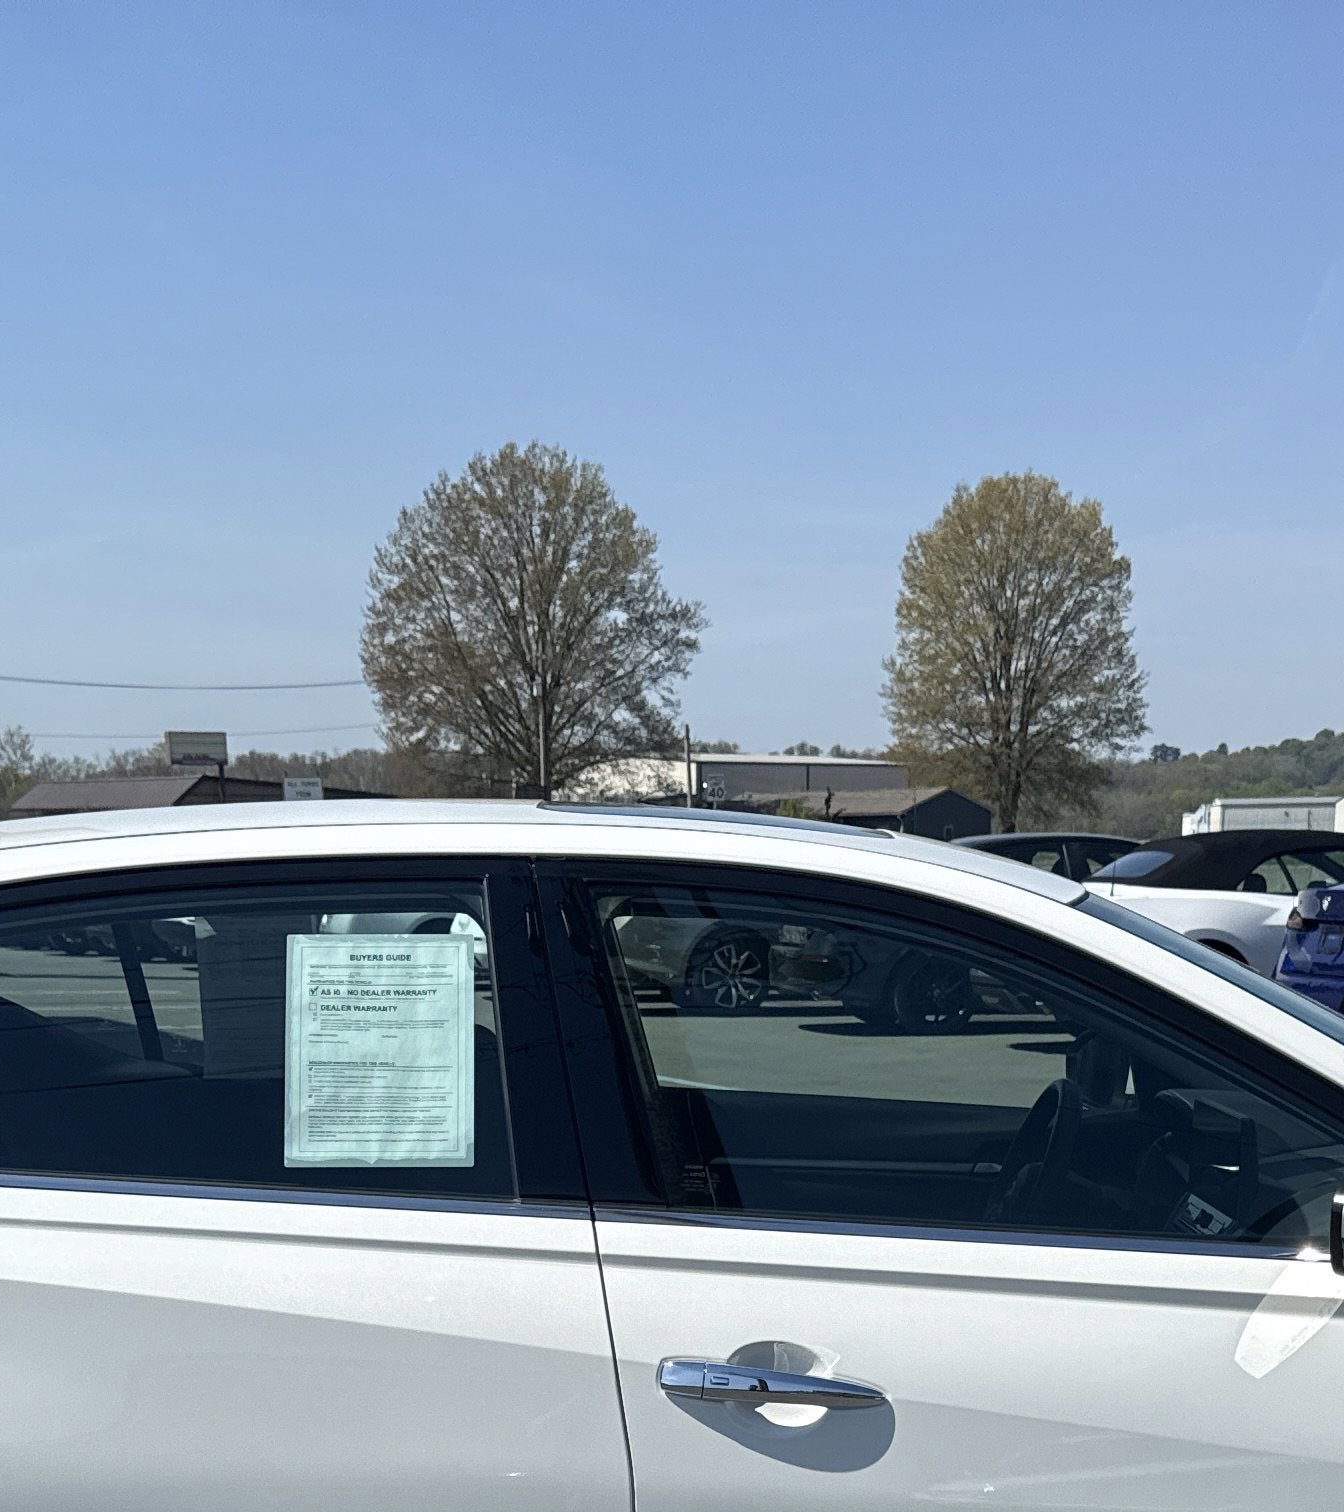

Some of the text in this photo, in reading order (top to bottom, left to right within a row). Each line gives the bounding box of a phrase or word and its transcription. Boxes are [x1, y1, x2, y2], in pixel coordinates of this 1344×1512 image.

[708, 787, 725, 799] 40
[349, 954, 412, 962] BUYERS GUIDE
[320, 988, 331, 996] AS
[360, 989, 392, 997] DEALER
[393, 989, 438, 997] WARRANTY
[320, 1004, 398, 1013] DEALER WARRANTY
